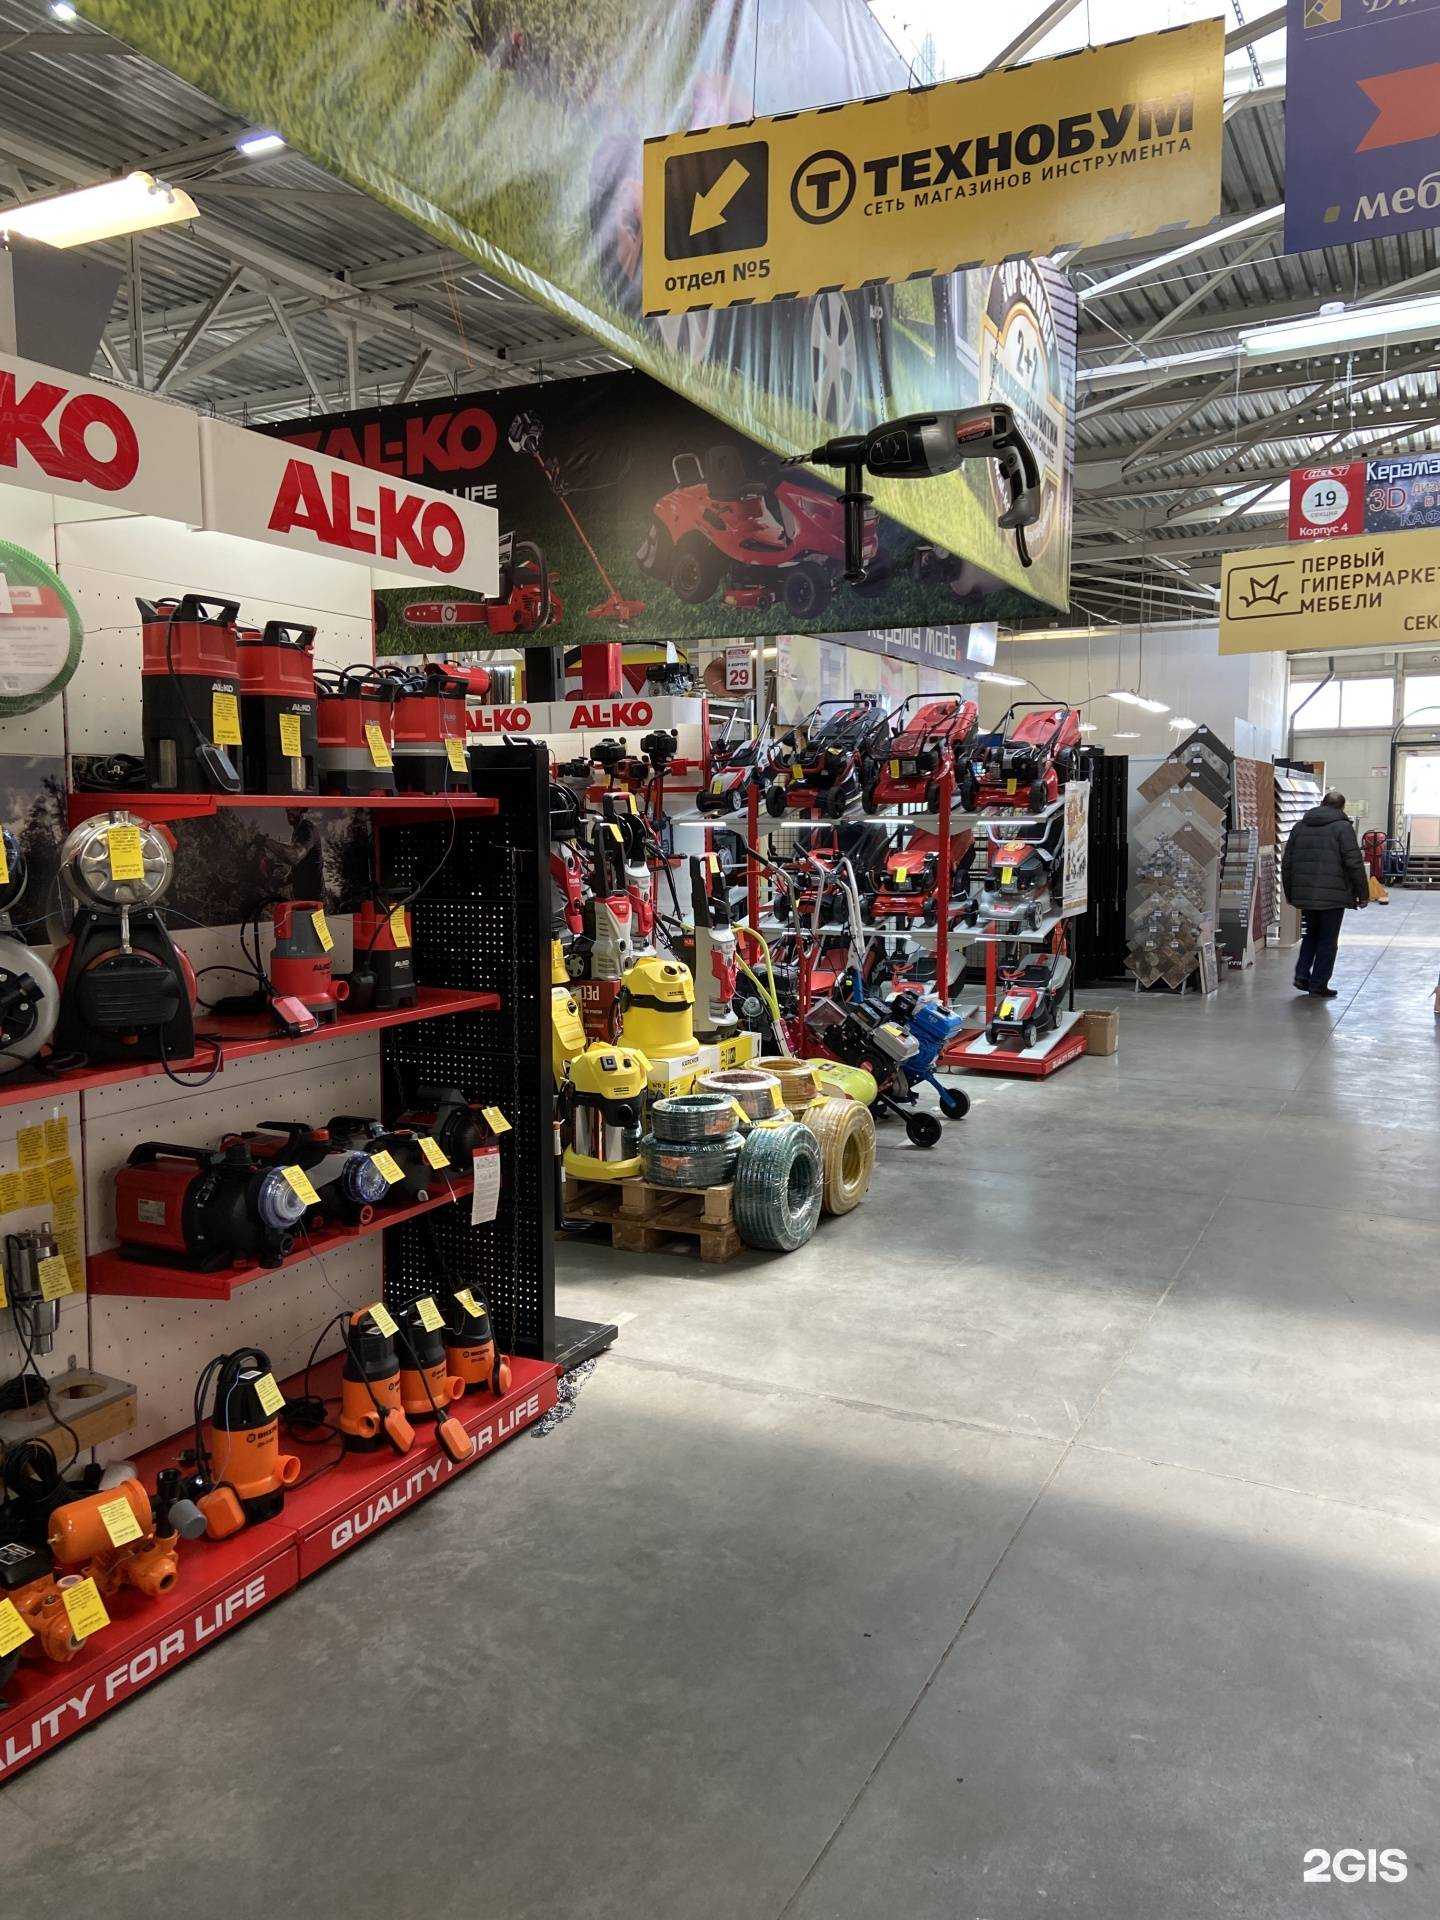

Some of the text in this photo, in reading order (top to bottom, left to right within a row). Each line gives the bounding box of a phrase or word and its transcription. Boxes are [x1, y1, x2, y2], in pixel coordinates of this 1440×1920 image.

[863, 97, 1195, 198] ТЕХНОБУМ
[863, 137, 1193, 218] СЕТЬ МАГАЗИНОВ ИНСТРУМЕНТА
[664, 258, 772, 293] отдел №5
[325, 408, 498, 477] AL-KO
[1314, 491, 1337, 507] 19
[1369, 487, 1408, 512] 3D
[268, 459, 465, 574] AL-KO
[1299, 523, 1349, 537] Корпус 4
[1301, 547, 1385, 574] ПЕРВЫЙ
[1300, 592, 1383, 614] МЕБЕЛИ
[1404, 614, 1440, 631] СЕК
[729, 669, 749, 686] 29
[569, 701, 654, 729] AL-KO
[332, 1393, 540, 1550] QUALITY LIFE
[106, 1629, 186, 1701] FOR
[195, 1575, 266, 1642] LIFE
